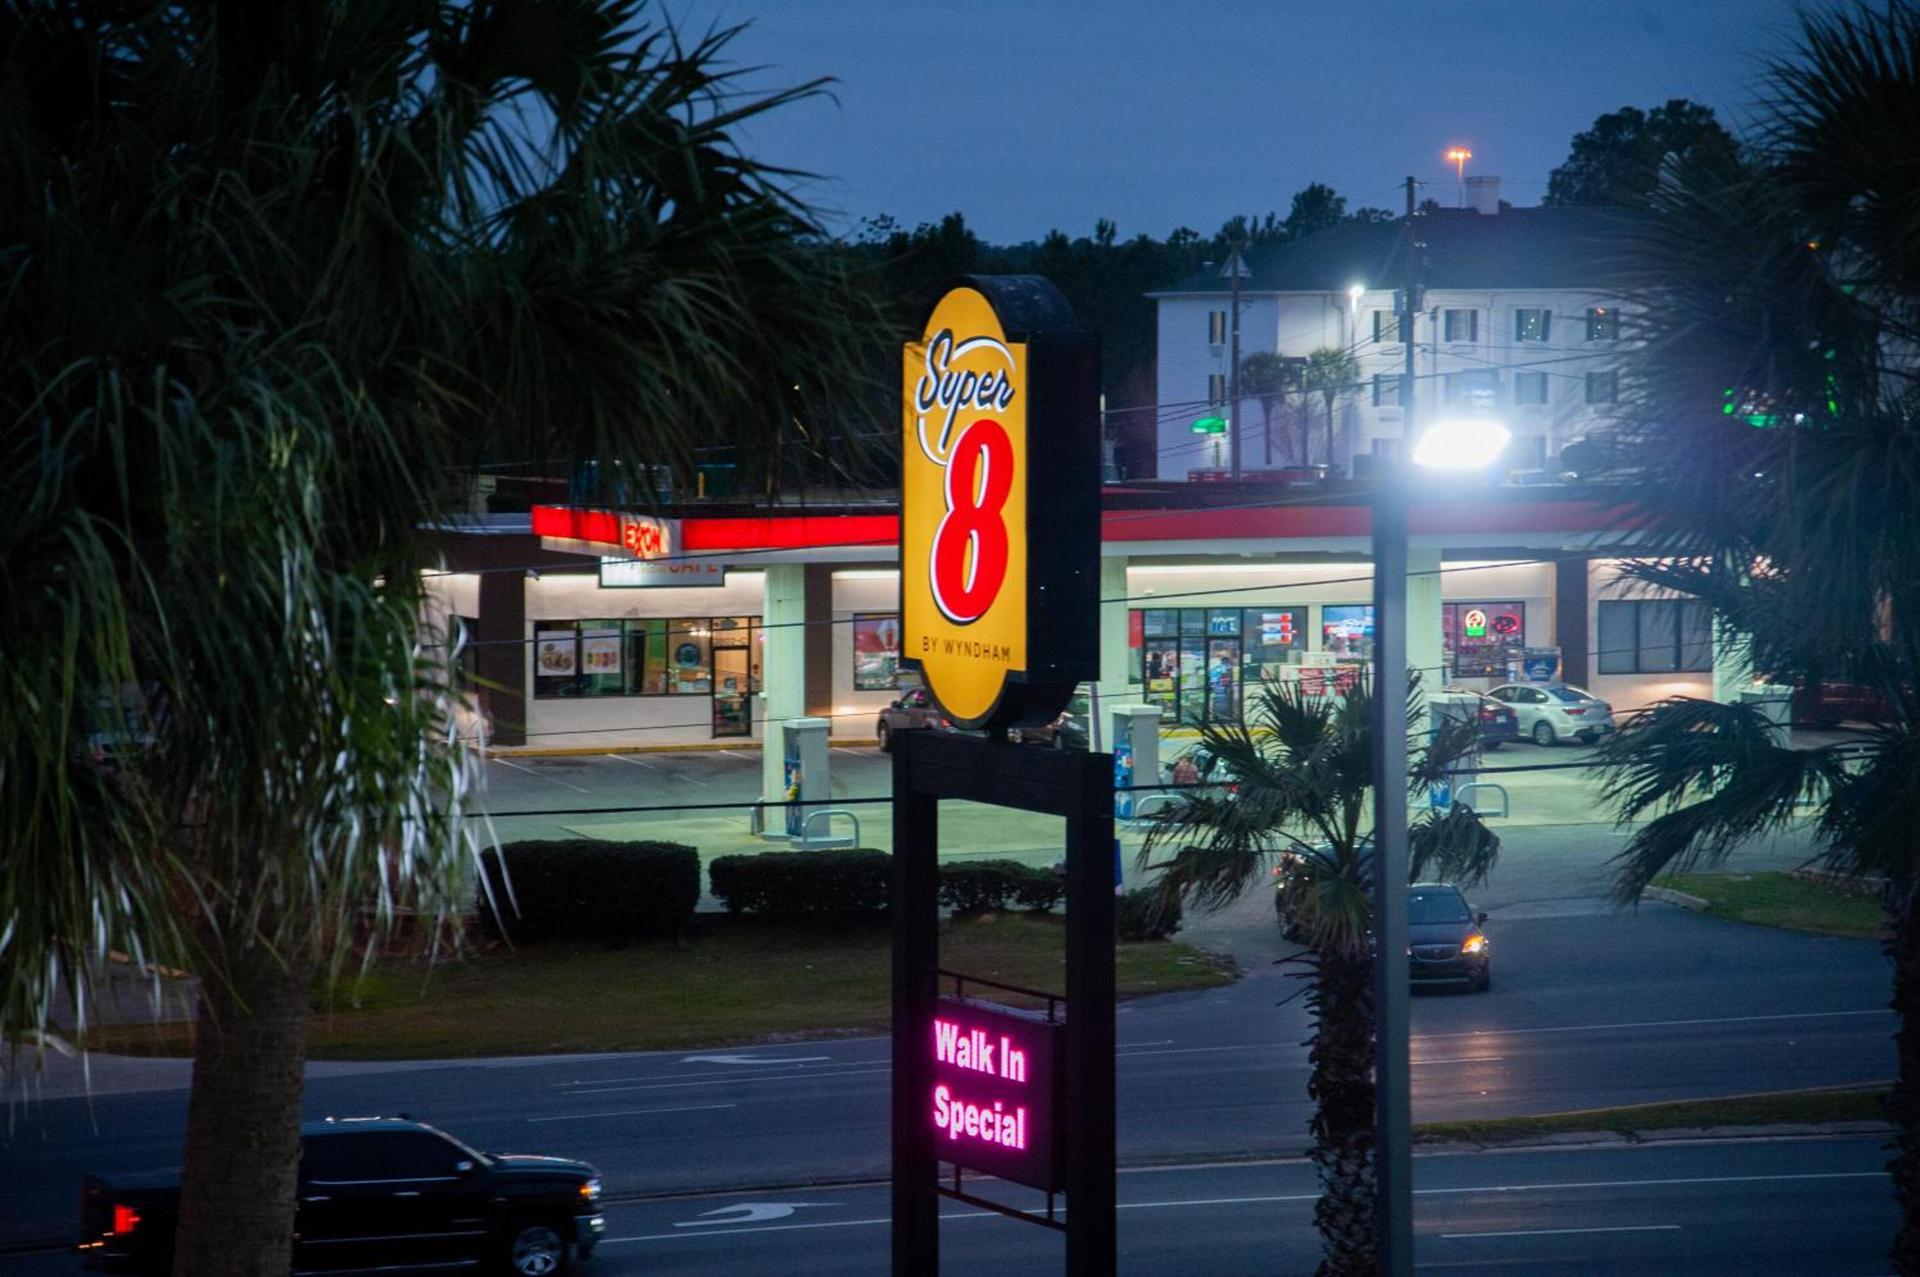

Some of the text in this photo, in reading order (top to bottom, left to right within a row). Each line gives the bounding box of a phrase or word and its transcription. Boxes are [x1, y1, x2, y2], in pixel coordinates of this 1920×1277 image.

[915, 328, 1015, 454] Super
[929, 418, 1015, 626] 8
[922, 636, 1010, 662] BY WYNDHAM
[934, 1020, 1025, 1082] Walk In
[934, 1085, 1025, 1150] Special
